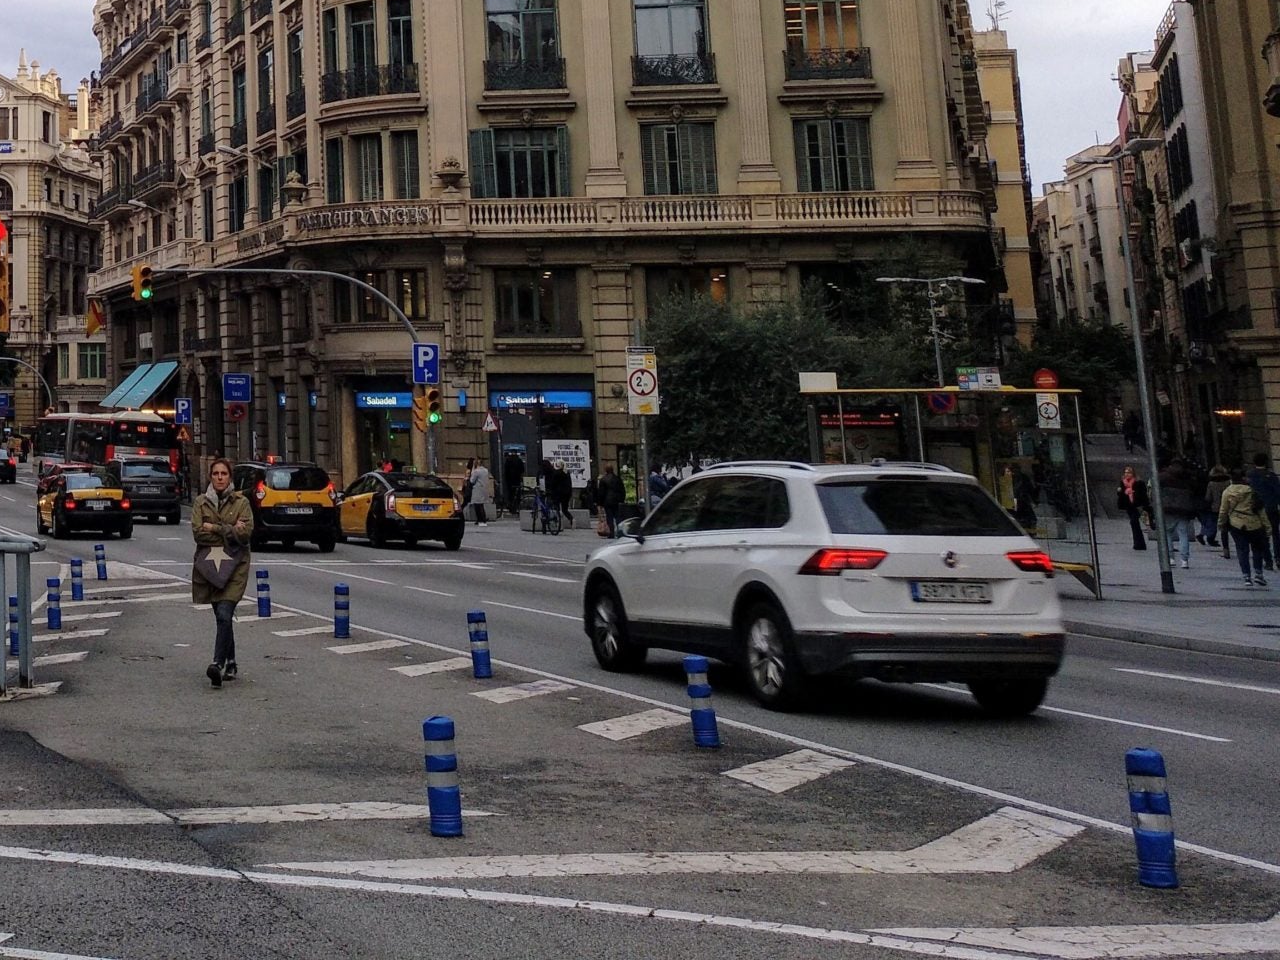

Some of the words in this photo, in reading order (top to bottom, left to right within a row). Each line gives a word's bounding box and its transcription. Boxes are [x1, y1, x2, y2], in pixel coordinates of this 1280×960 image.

[418, 346, 434, 368] P
[636, 376, 642, 387] 2
[366, 396, 397, 405] Sabadell
[177, 400, 189, 414] P
